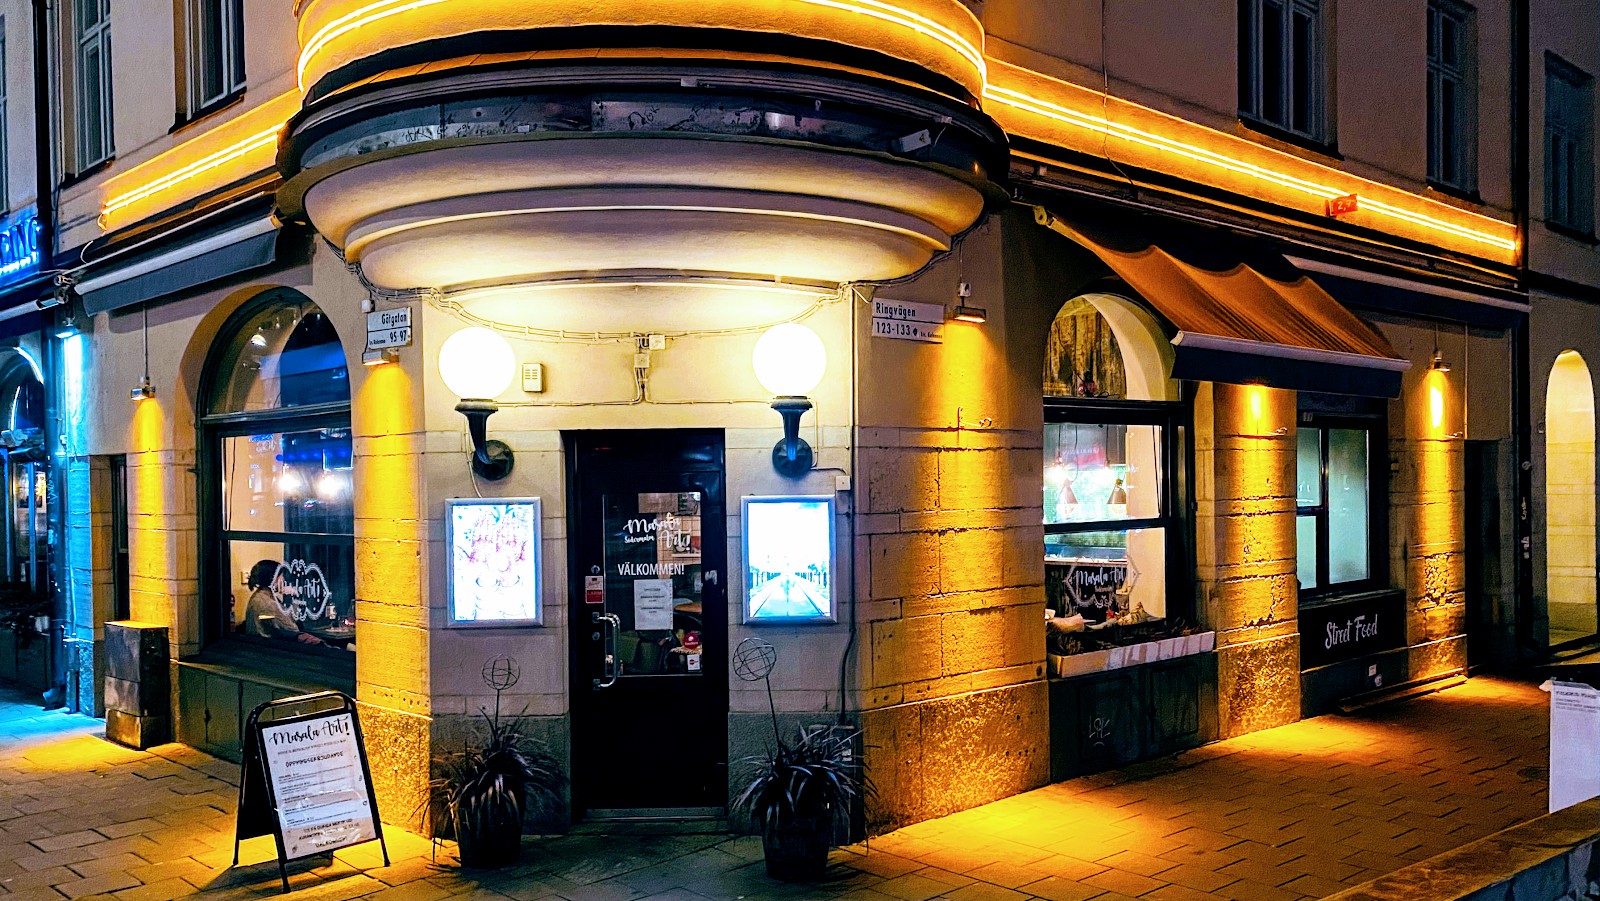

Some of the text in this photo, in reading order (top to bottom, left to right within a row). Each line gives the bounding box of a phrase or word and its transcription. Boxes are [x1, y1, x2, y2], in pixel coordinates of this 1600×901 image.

[381, 312, 407, 327] Götgatan
[876, 302, 916, 319] Ringvägen
[876, 321, 911, 336] 123-133
[623, 512, 682, 534] Masala
[658, 528, 692, 551] Art!
[617, 561, 685, 576] VÄLKOMMEN!
[1324, 613, 1378, 649] Street Food
[269, 716, 350, 745] Masala Art!
